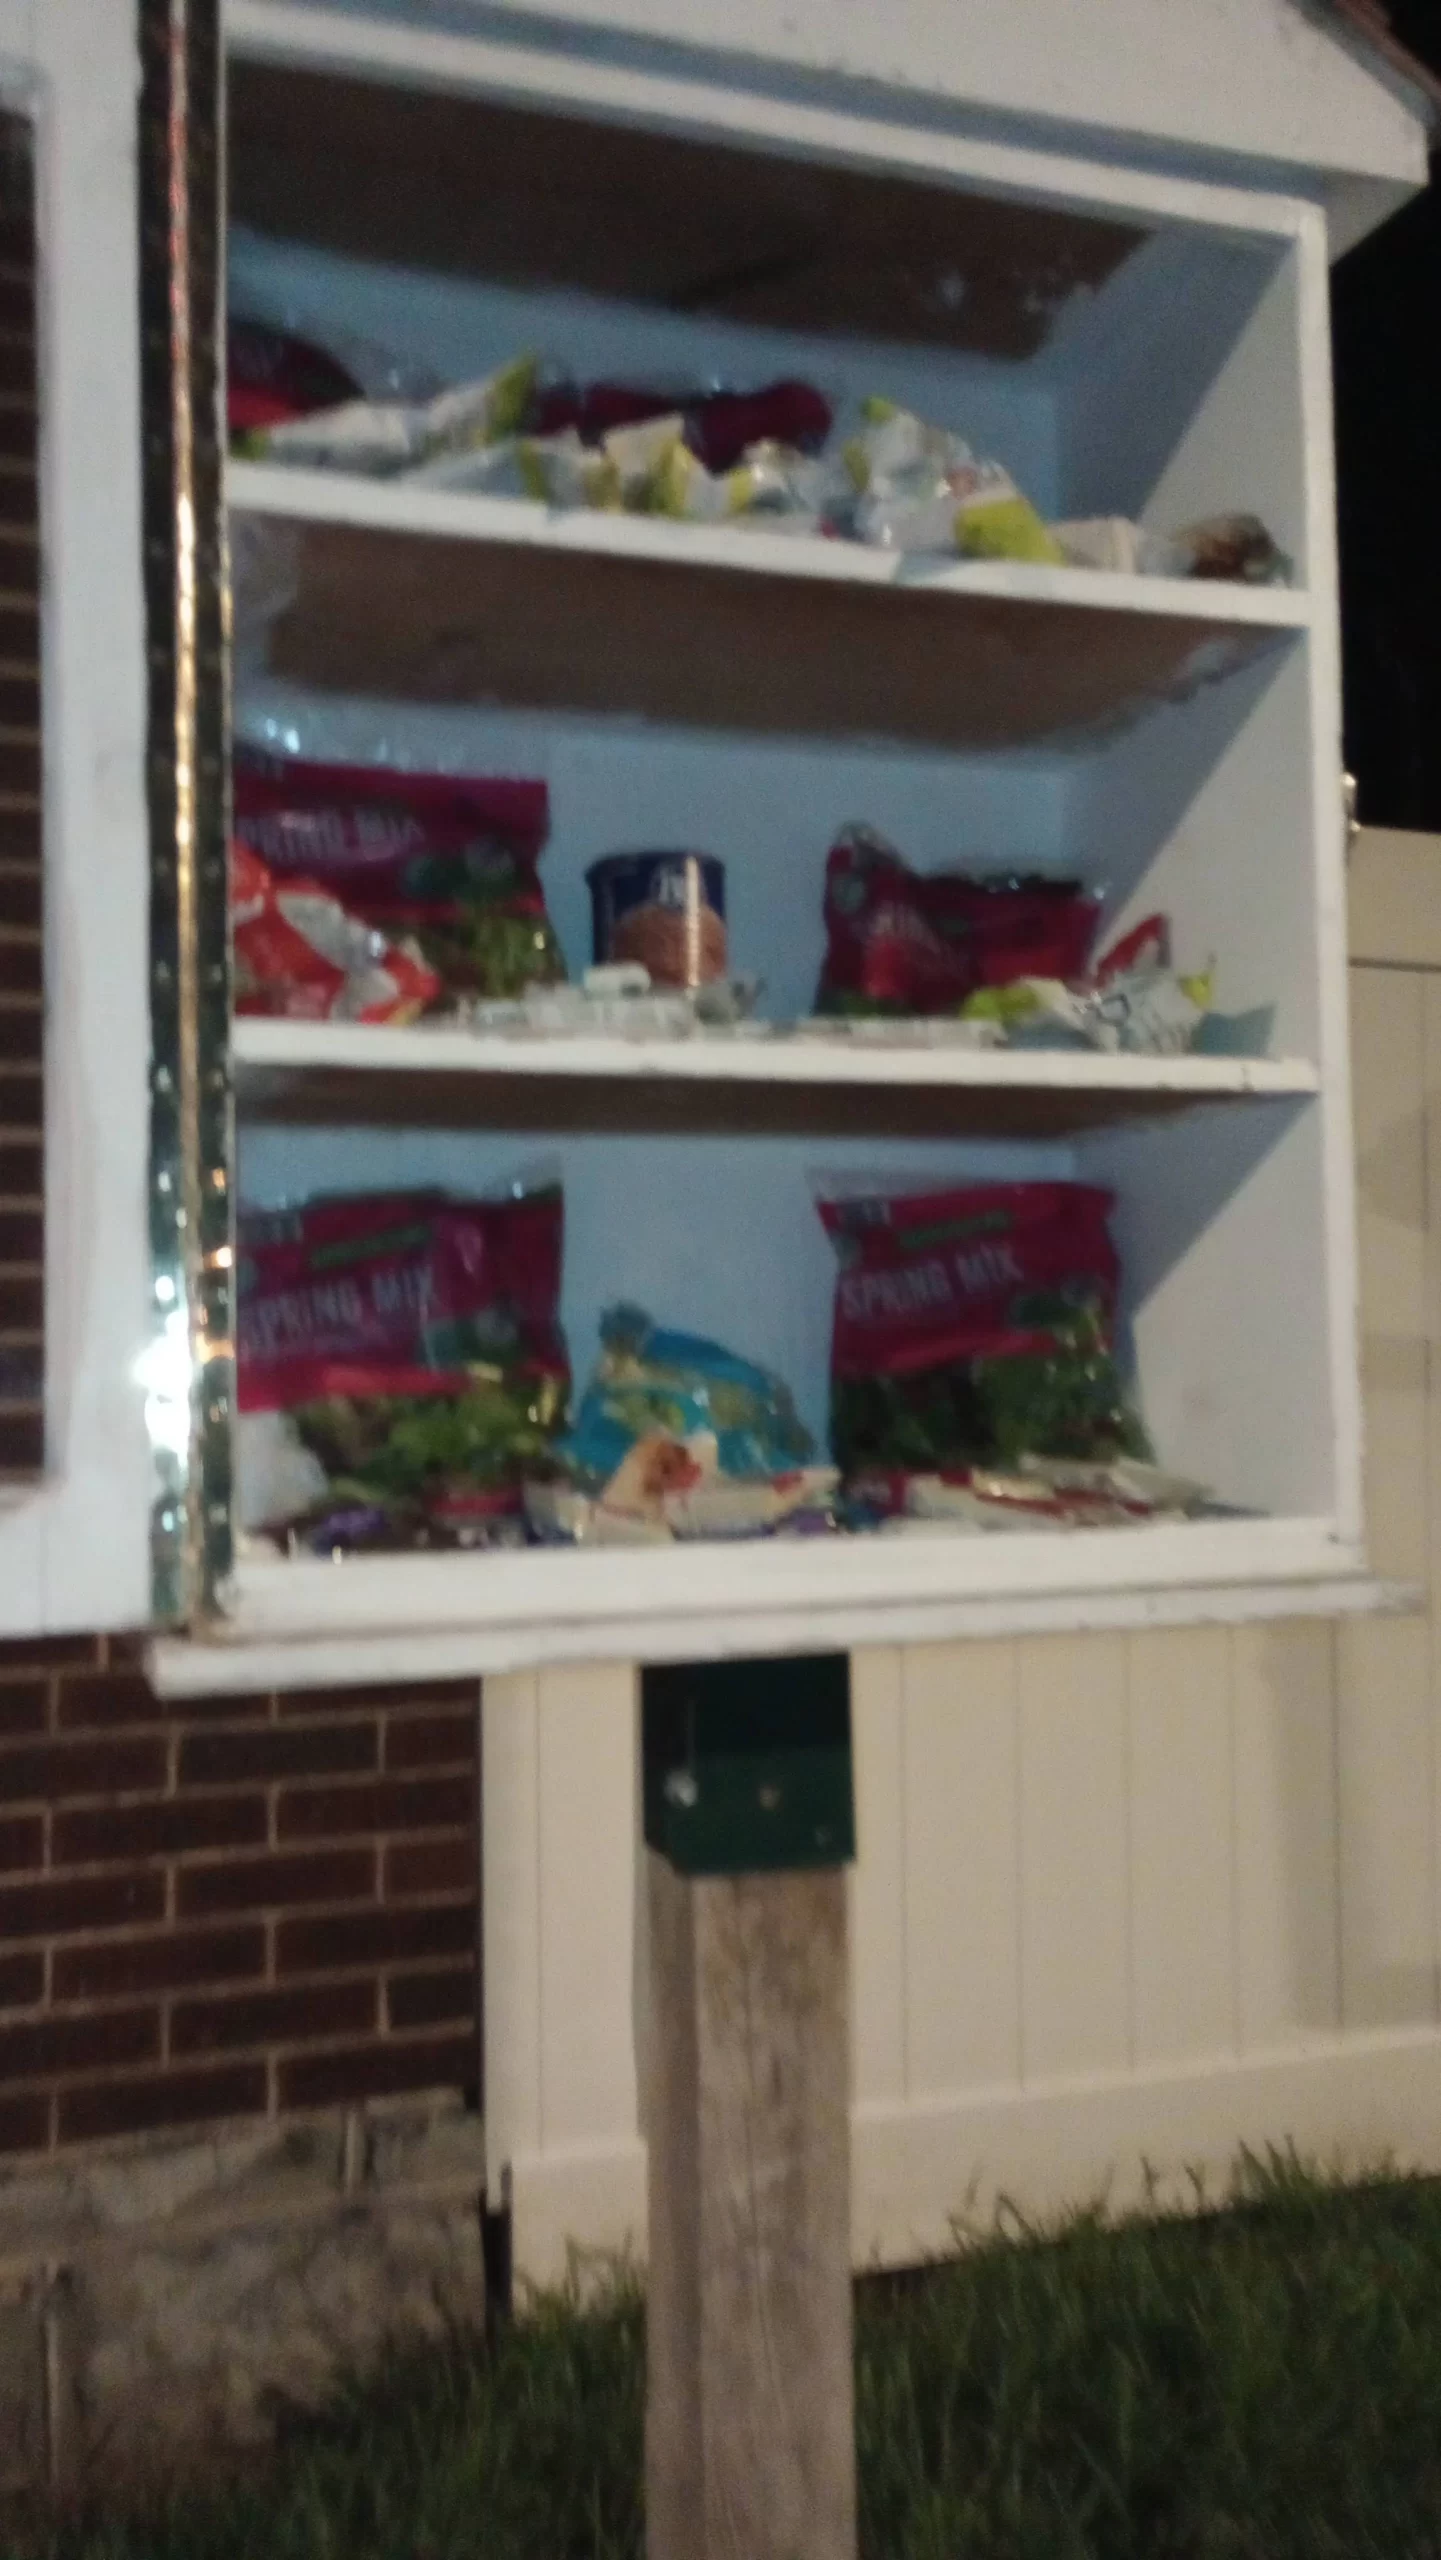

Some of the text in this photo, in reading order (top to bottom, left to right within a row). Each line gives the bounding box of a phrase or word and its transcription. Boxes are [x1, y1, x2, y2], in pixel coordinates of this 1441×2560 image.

[372, 1262, 436, 1314] MIX
[841, 1239, 1024, 1321] SPRING MIX
